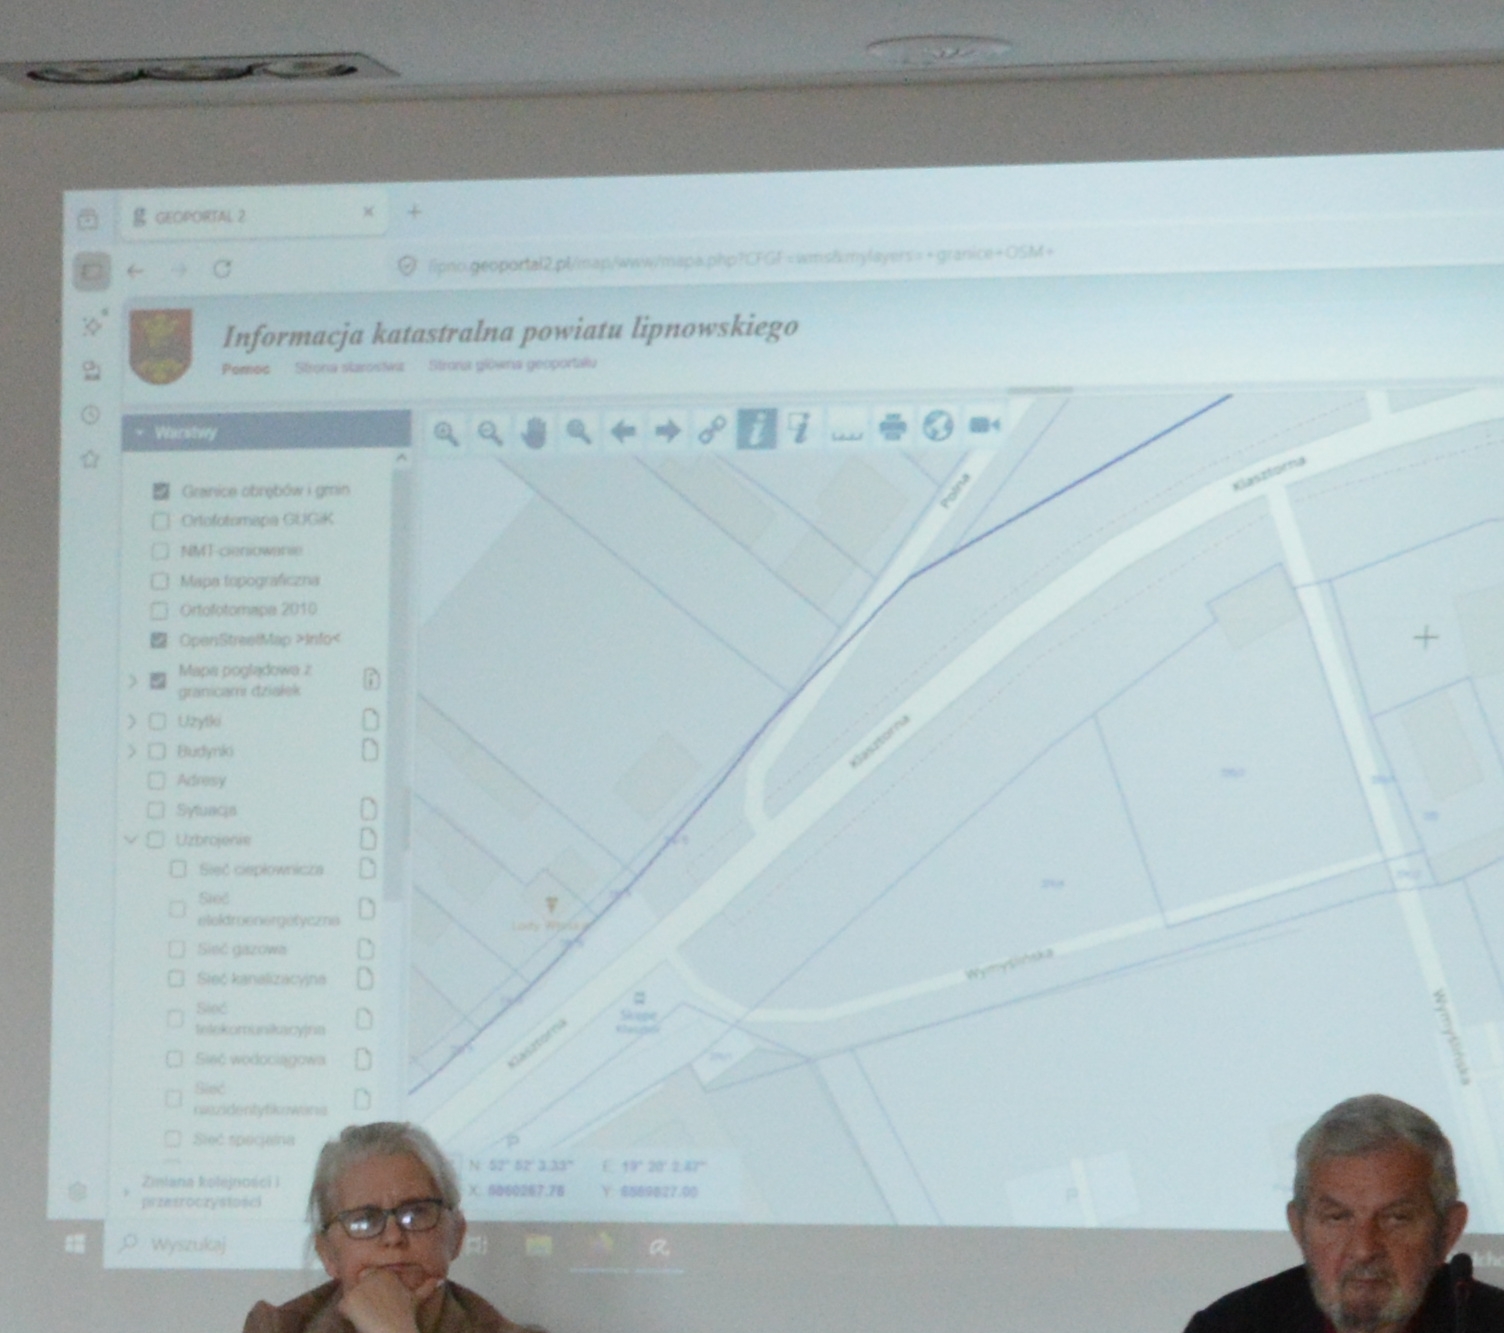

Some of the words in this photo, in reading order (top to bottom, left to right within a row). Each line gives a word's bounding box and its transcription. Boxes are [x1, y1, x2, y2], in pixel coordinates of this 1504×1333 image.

[155, 208, 233, 224] GEOPORTAL
[237, 208, 247, 222] 2
[223, 322, 362, 354] Informacja
[372, 317, 514, 347] katastralna
[521, 318, 623, 348] powiatu
[631, 312, 801, 347] lipnowskiego
[222, 363, 270, 376] Pomoc
[295, 362, 337, 374] Strona
[429, 359, 472, 371] Strona
[527, 356, 597, 374] geoportalu
[182, 484, 238, 498] Granice
[241, 484, 302, 499] obrębów
[315, 485, 350, 499] gmin
[181, 514, 279, 528] Ortofotomapa
[180, 574, 220, 588] Mapa
[224, 573, 320, 589] topograficzna
[180, 603, 277, 618] Ortofotomapa
[282, 602, 317, 615] 2010
[179, 633, 291, 648] OpenStreetMap
[179, 664, 218, 677] Mapa
[178, 685, 247, 701] granicami
[176, 744, 234, 759] Budynki
[176, 773, 226, 788] Adresy
[176, 804, 236, 819] Sytuacja
[176, 833, 252, 849] Uzbrojenie
[232, 972, 328, 988] kanalizacyjna
[151, 1236, 227, 1255] Wyszukaj
